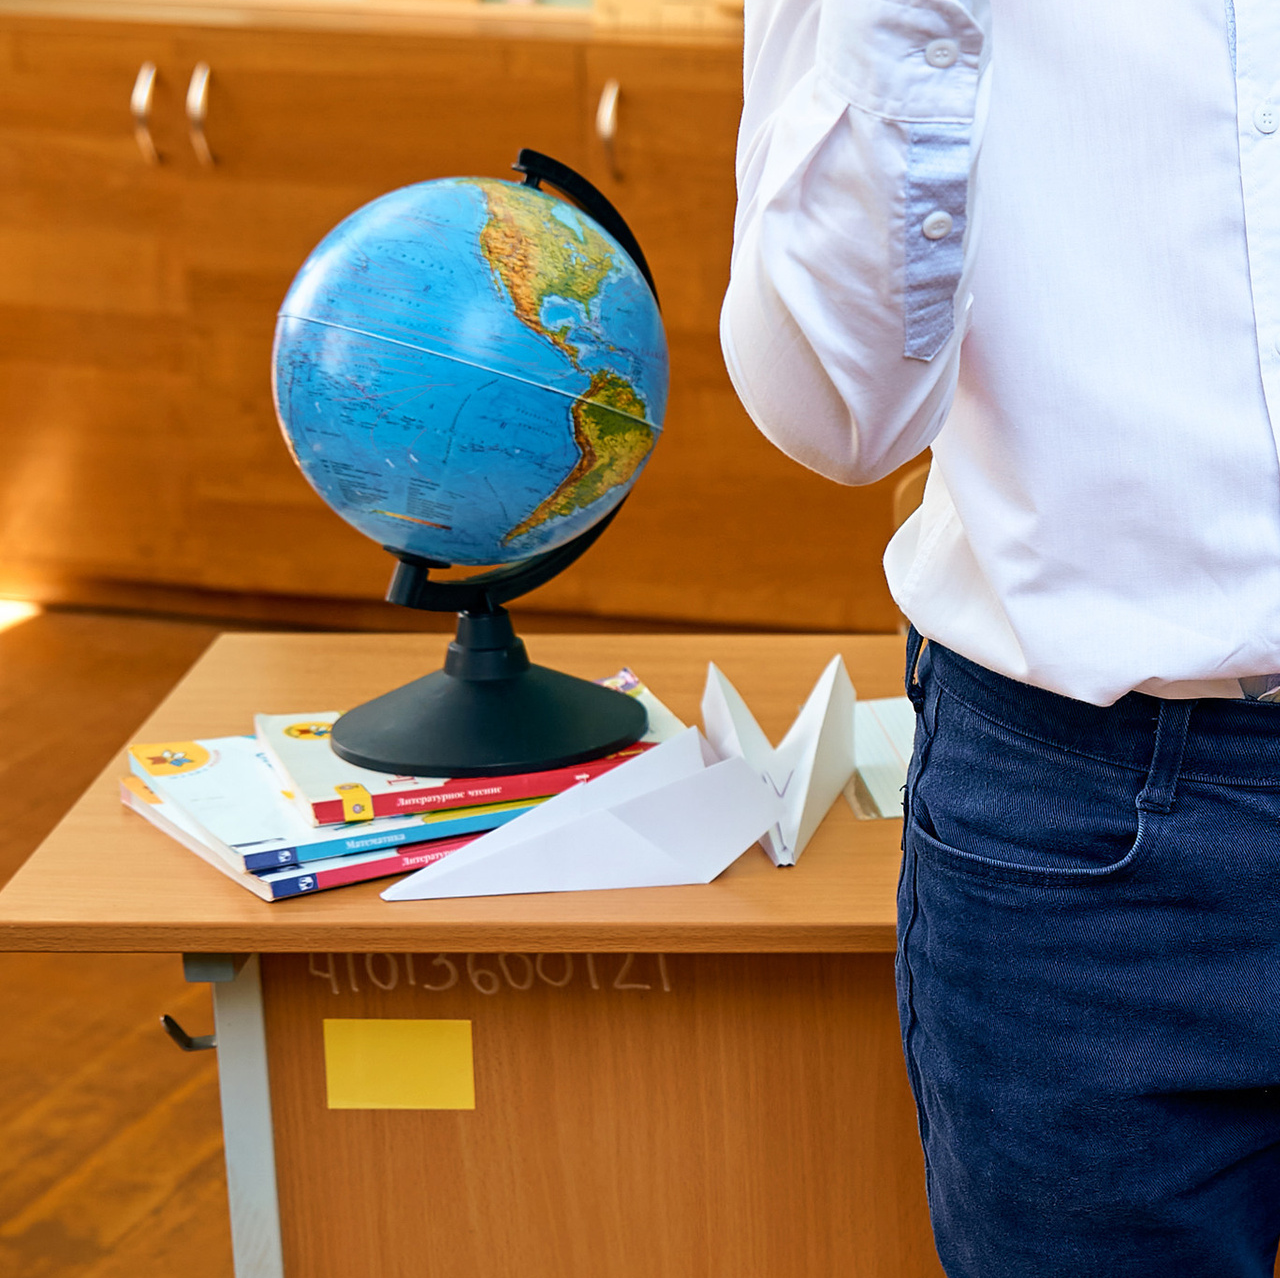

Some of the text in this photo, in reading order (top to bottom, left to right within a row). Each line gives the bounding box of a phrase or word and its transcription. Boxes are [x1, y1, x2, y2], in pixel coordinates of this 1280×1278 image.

[397, 784, 502, 807] Литературное чтение
[345, 832, 406, 850] Математика
